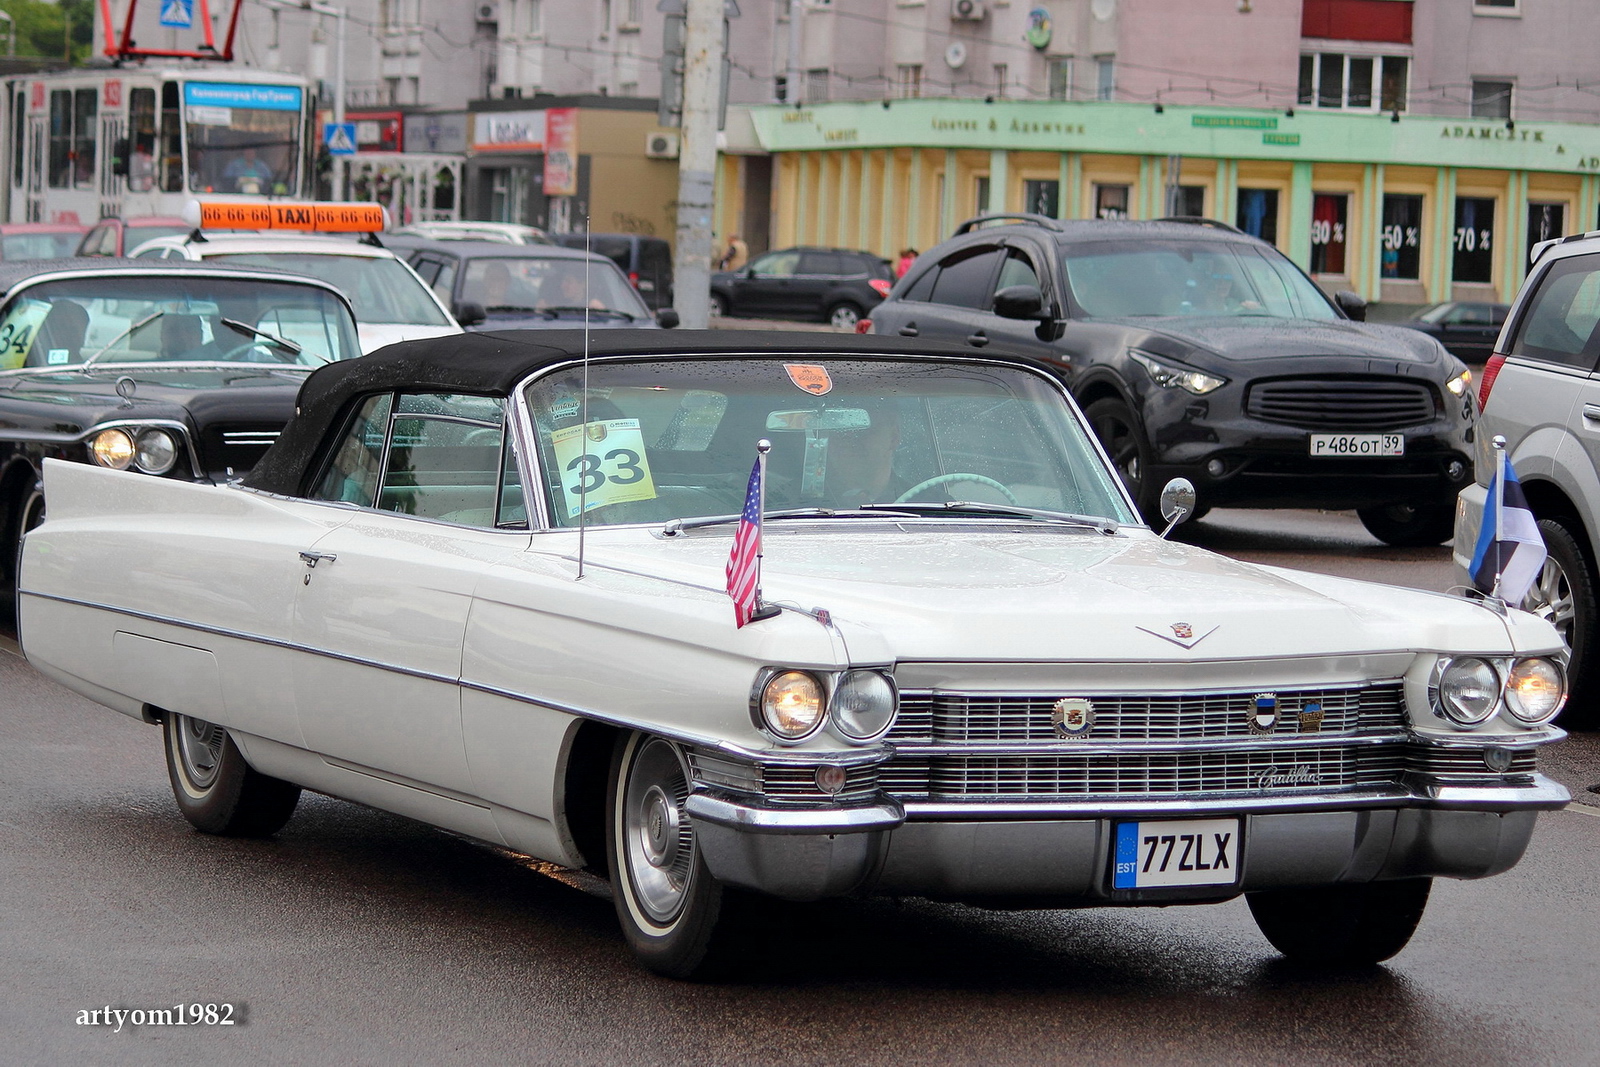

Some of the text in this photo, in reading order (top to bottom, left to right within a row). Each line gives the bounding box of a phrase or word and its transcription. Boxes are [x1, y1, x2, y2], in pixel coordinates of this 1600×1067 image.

[203, 207, 382, 224] 66-66-66 TAXI 66-66-66
[0, 324, 33, 354] 34
[1384, 436, 1399, 449] 39
[566, 448, 645, 495] 33
[1254, 765, 1323, 790] Cadillac
[1117, 833, 1231, 873] EST 77ZLX
